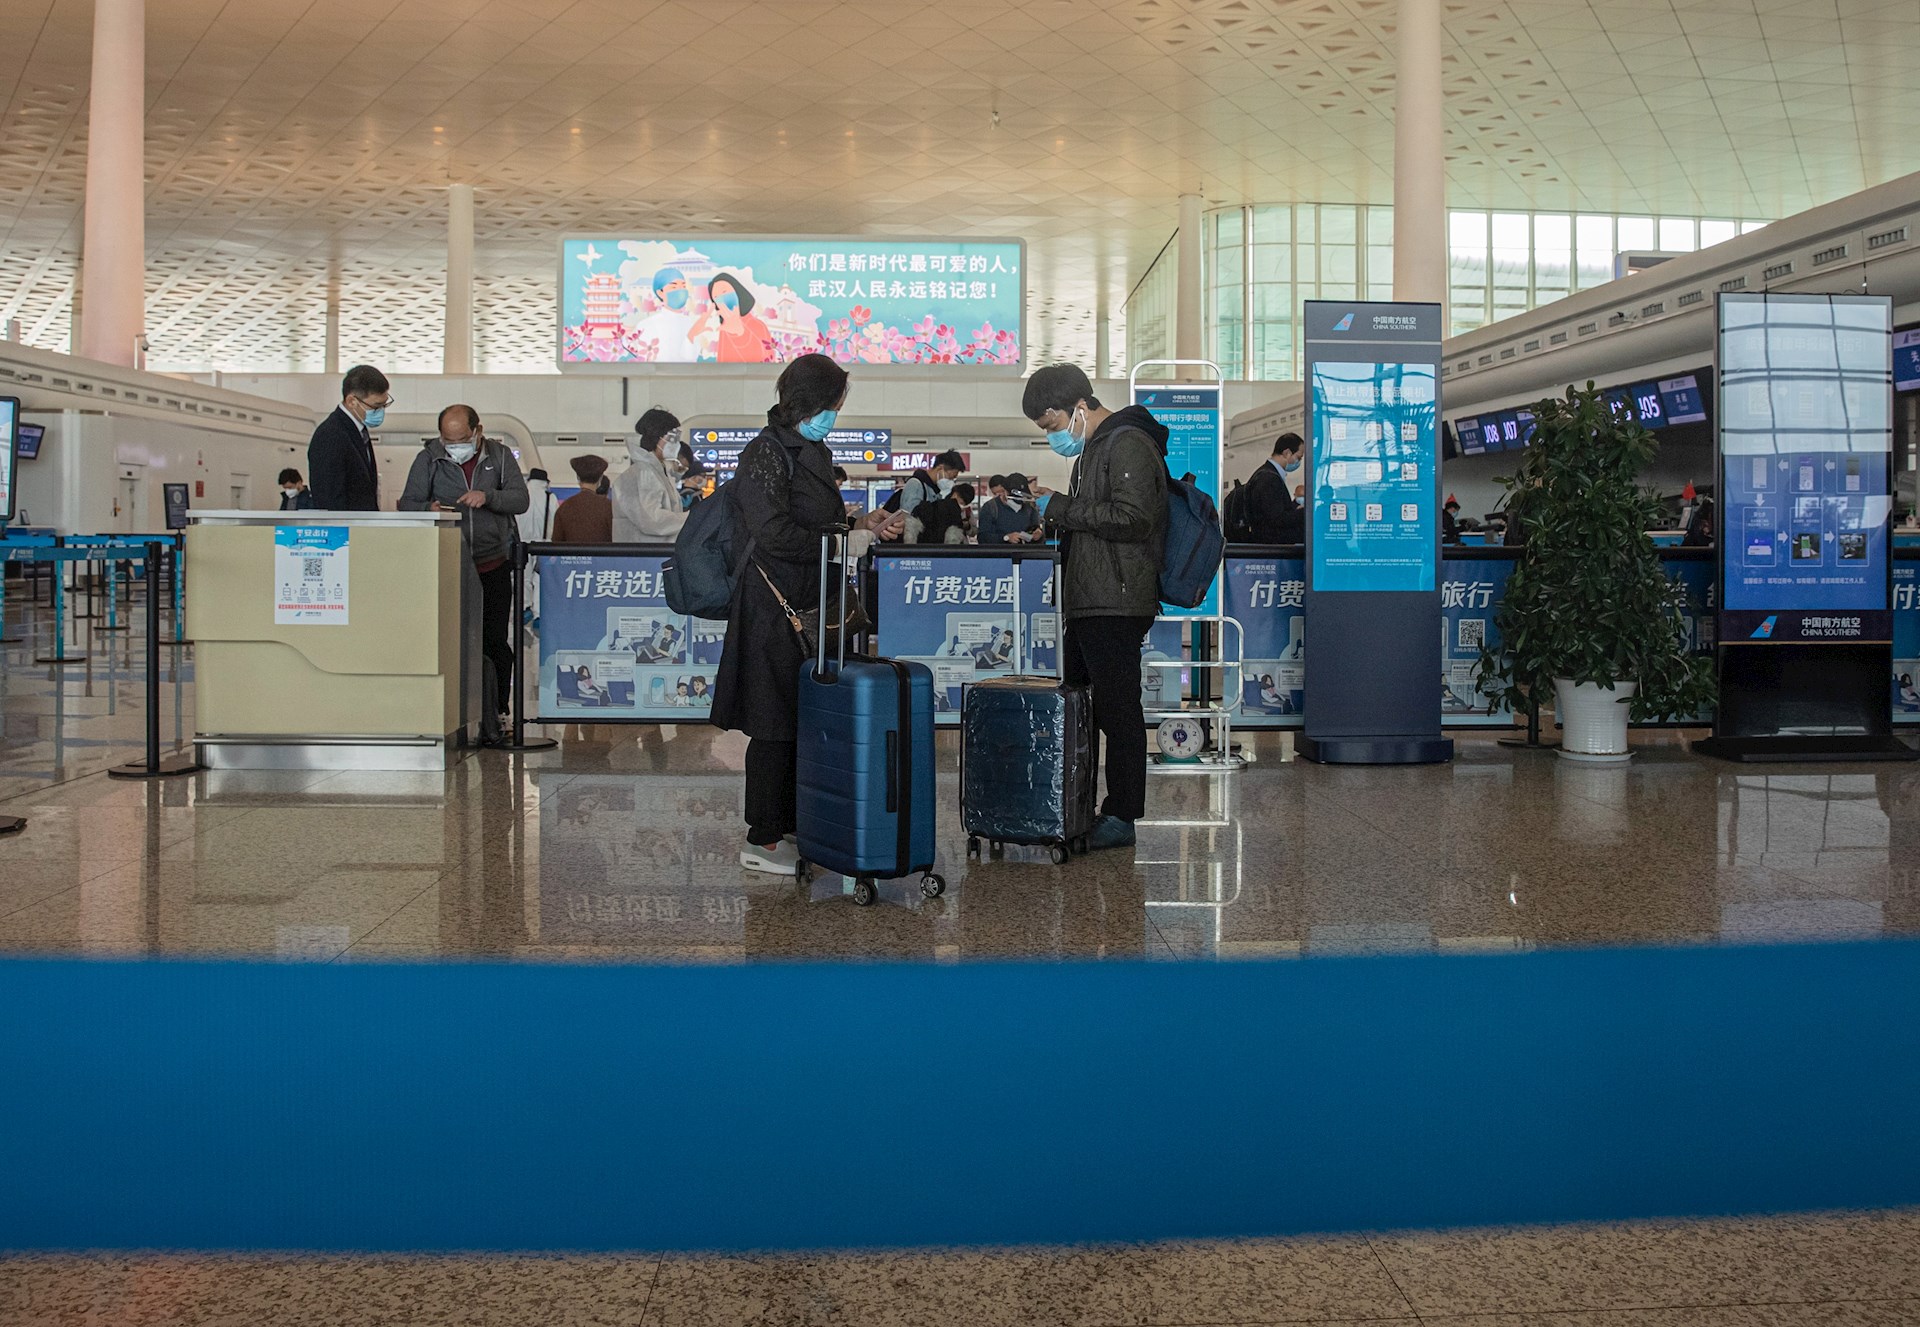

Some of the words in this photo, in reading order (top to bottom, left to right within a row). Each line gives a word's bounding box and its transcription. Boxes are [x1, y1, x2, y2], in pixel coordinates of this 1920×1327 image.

[788, 253, 1017, 274] 你们是新时代最可爱的人，
[808, 279, 997, 299] 武汉人民永远铭记您！
[1372, 316, 1417, 325] 中国南方航空
[1637, 394, 1661, 420] J05
[1483, 424, 1500, 444] J08
[1502, 420, 1518, 441] J07
[892, 453, 924, 470] RELAY
[904, 575, 1022, 604] 付费选座
[1250, 579, 1305, 608] 付费
[1441, 581, 1494, 609] 旅行
[1801, 617, 1861, 628] 中国南方航空
[1801, 628, 1823, 636] CHINA
[1824, 628, 1861, 636] SOUTHERN
